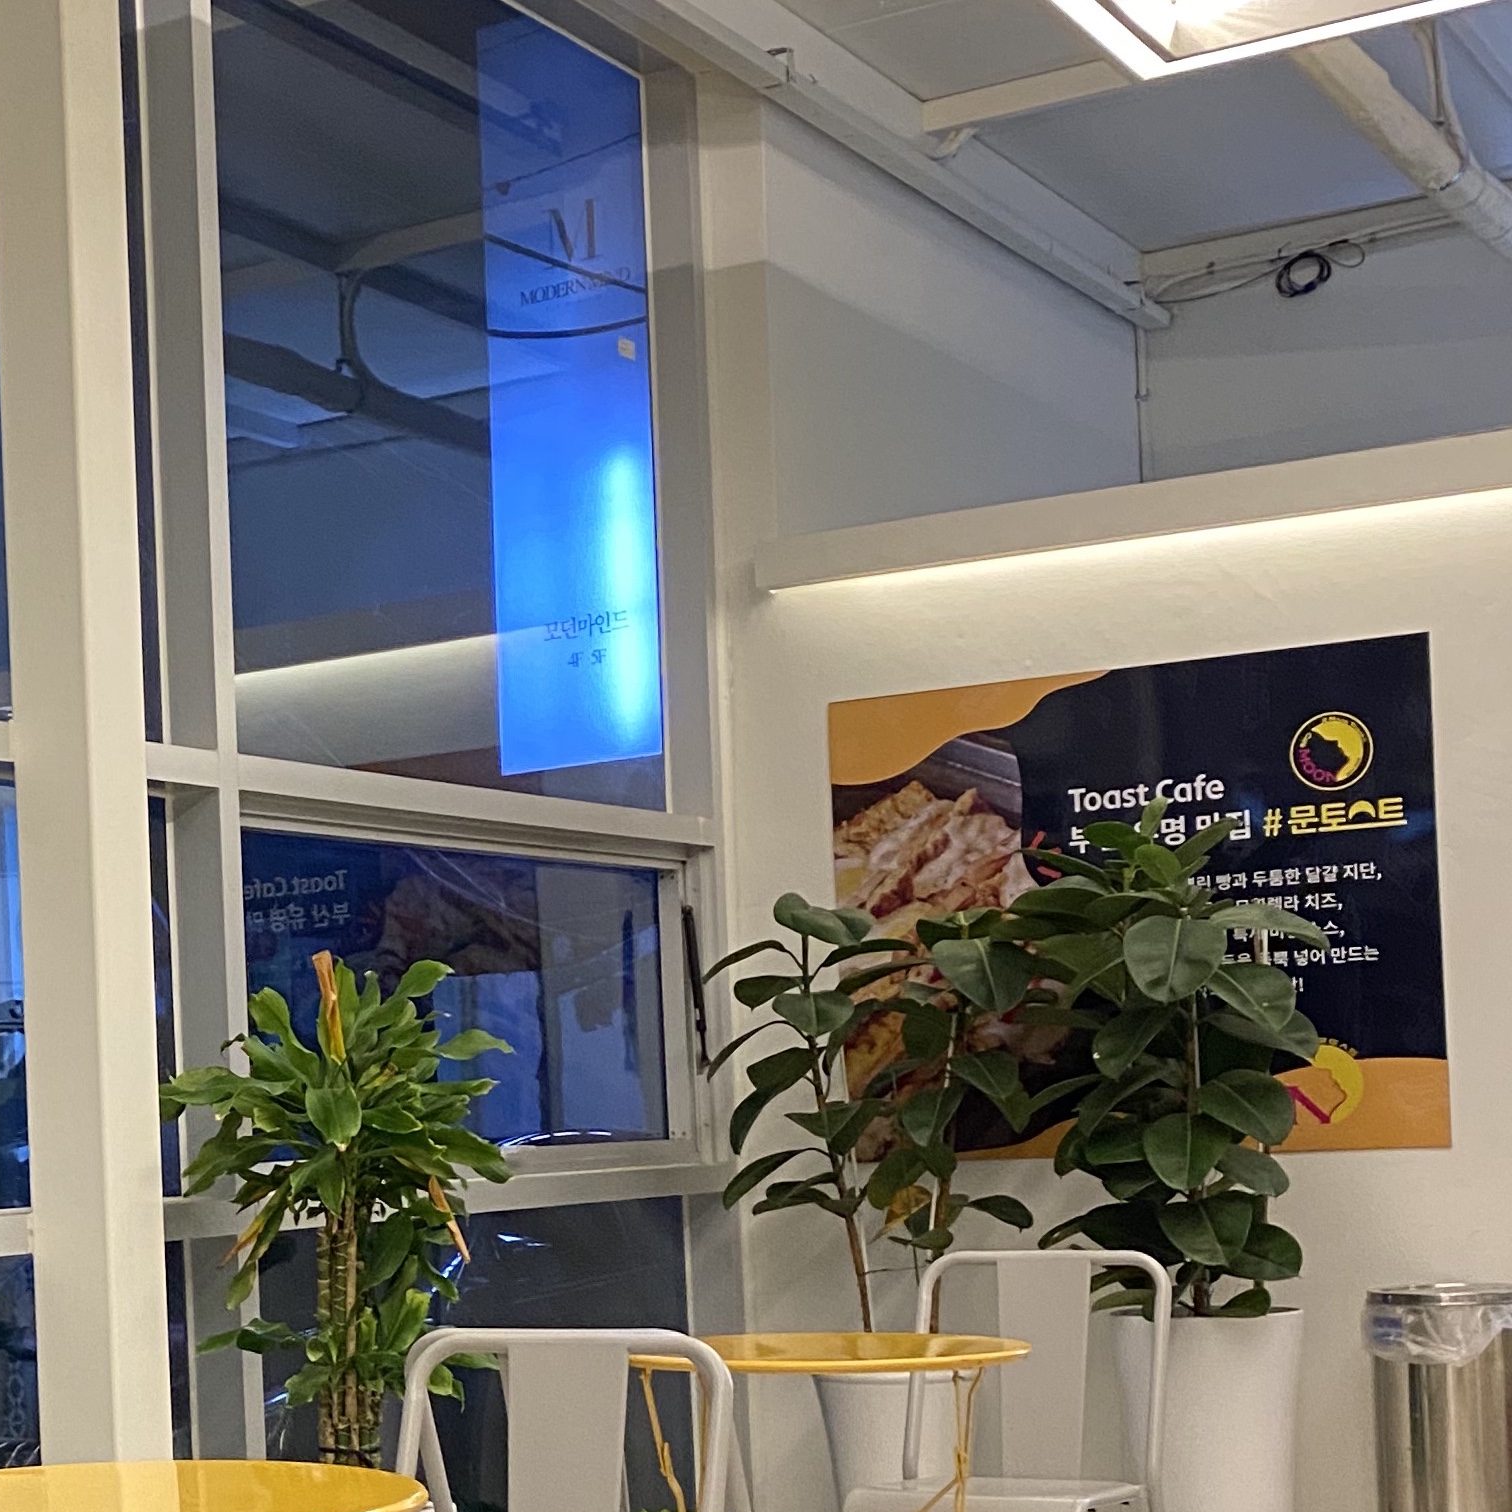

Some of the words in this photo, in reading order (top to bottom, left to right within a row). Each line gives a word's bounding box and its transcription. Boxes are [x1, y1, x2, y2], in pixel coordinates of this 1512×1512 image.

[520, 278, 586, 307] MODERN
[543, 610, 629, 642] 모던마인드
[1068, 783, 1150, 813] Toast
[1155, 773, 1225, 804] Cafe
[1133, 815, 1186, 846] 명
[1215, 872, 1248, 891] 빵과
[1252, 867, 1301, 887] 두툼한
[1305, 865, 1338, 884] 달걀
[1342, 862, 1382, 881] 지단,
[1304, 893, 1343, 910] 치즈,
[1294, 949, 1326, 966] 넣어
[1330, 946, 1380, 964] 만드는
